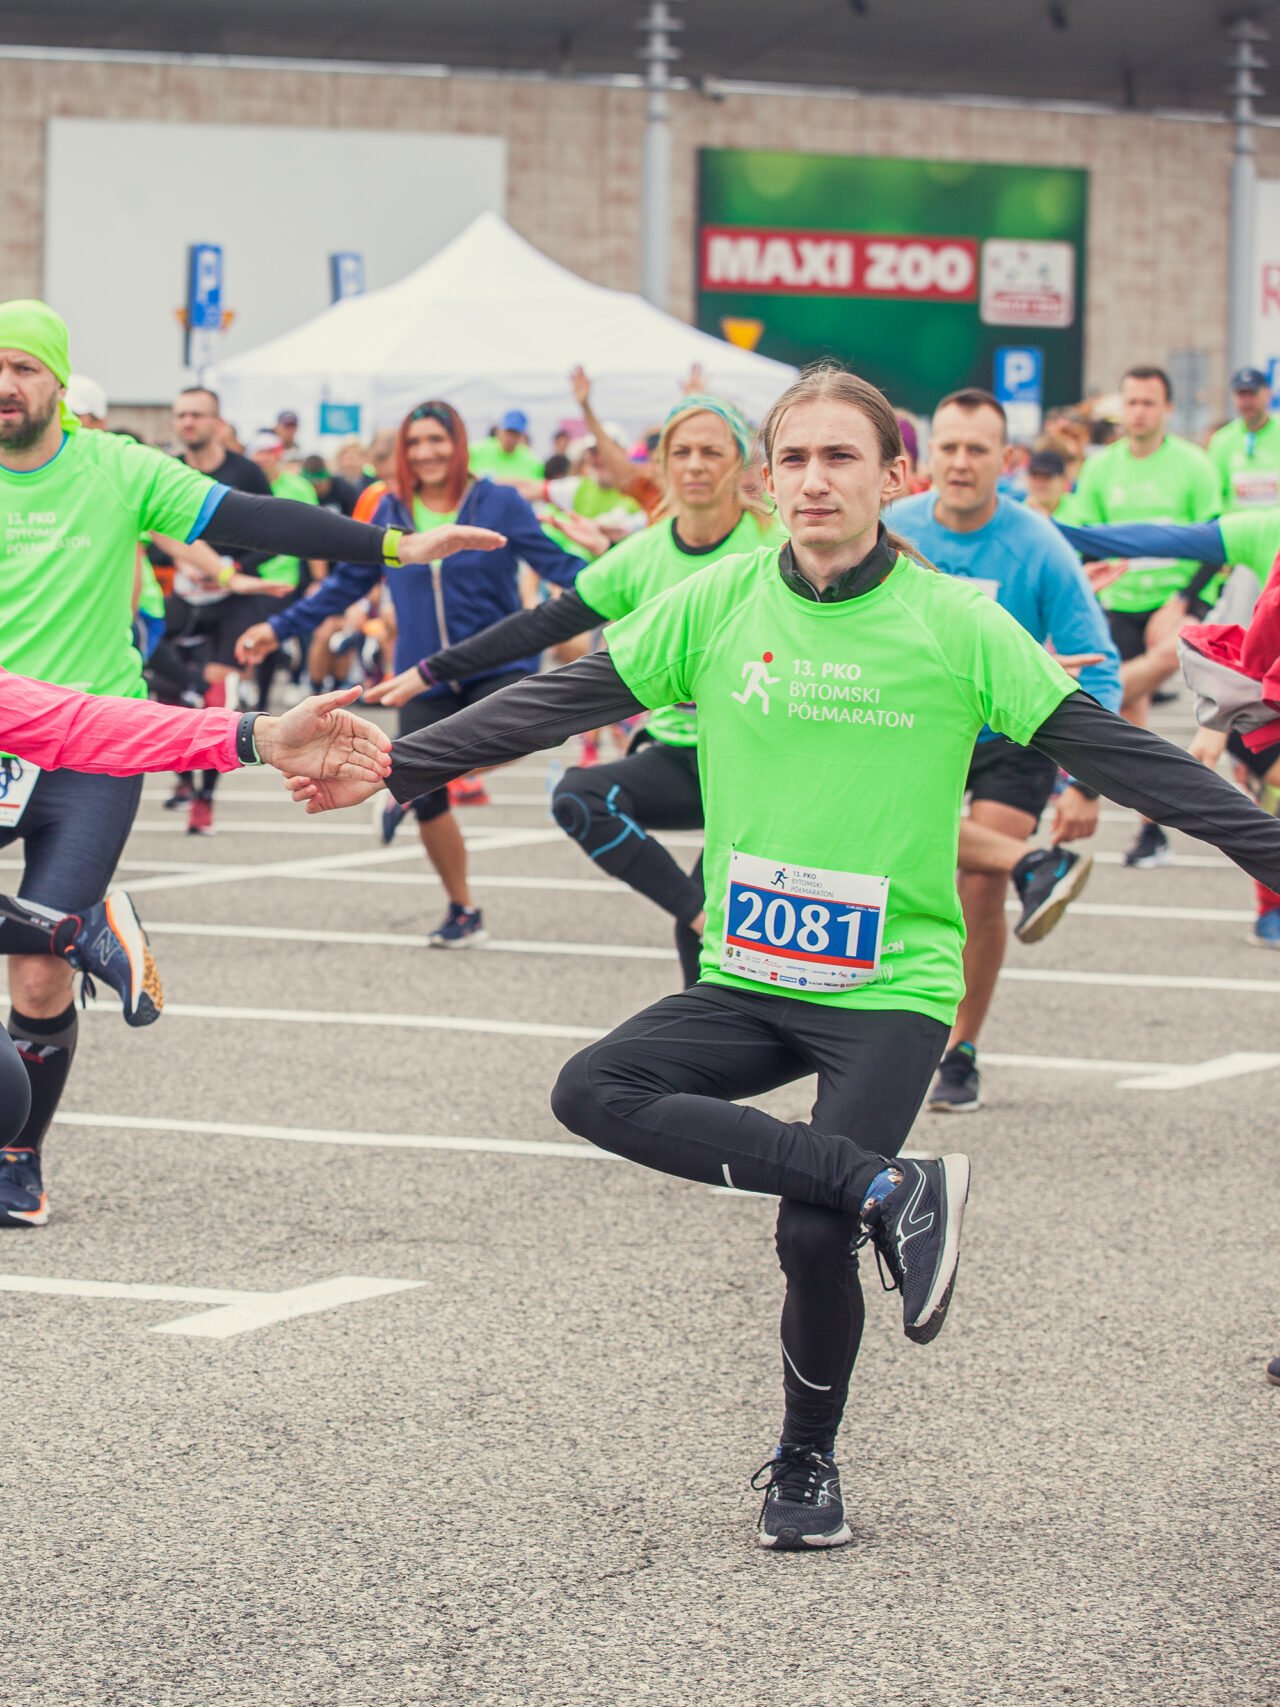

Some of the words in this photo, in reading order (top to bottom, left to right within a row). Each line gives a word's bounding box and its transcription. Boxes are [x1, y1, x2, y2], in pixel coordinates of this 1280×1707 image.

[706, 234, 854, 288] MAXI
[864, 241, 973, 293] ZOO
[1005, 351, 1035, 391] P
[792, 659, 816, 677] 13.
[821, 661, 863, 681] PKO
[789, 680, 881, 704] BYTOMSKI
[788, 700, 915, 729] PÓŁMARATON
[791, 878, 823, 889] BYTOMSKI
[803, 872, 817, 880] PKO
[735, 891, 862, 958] 2081
